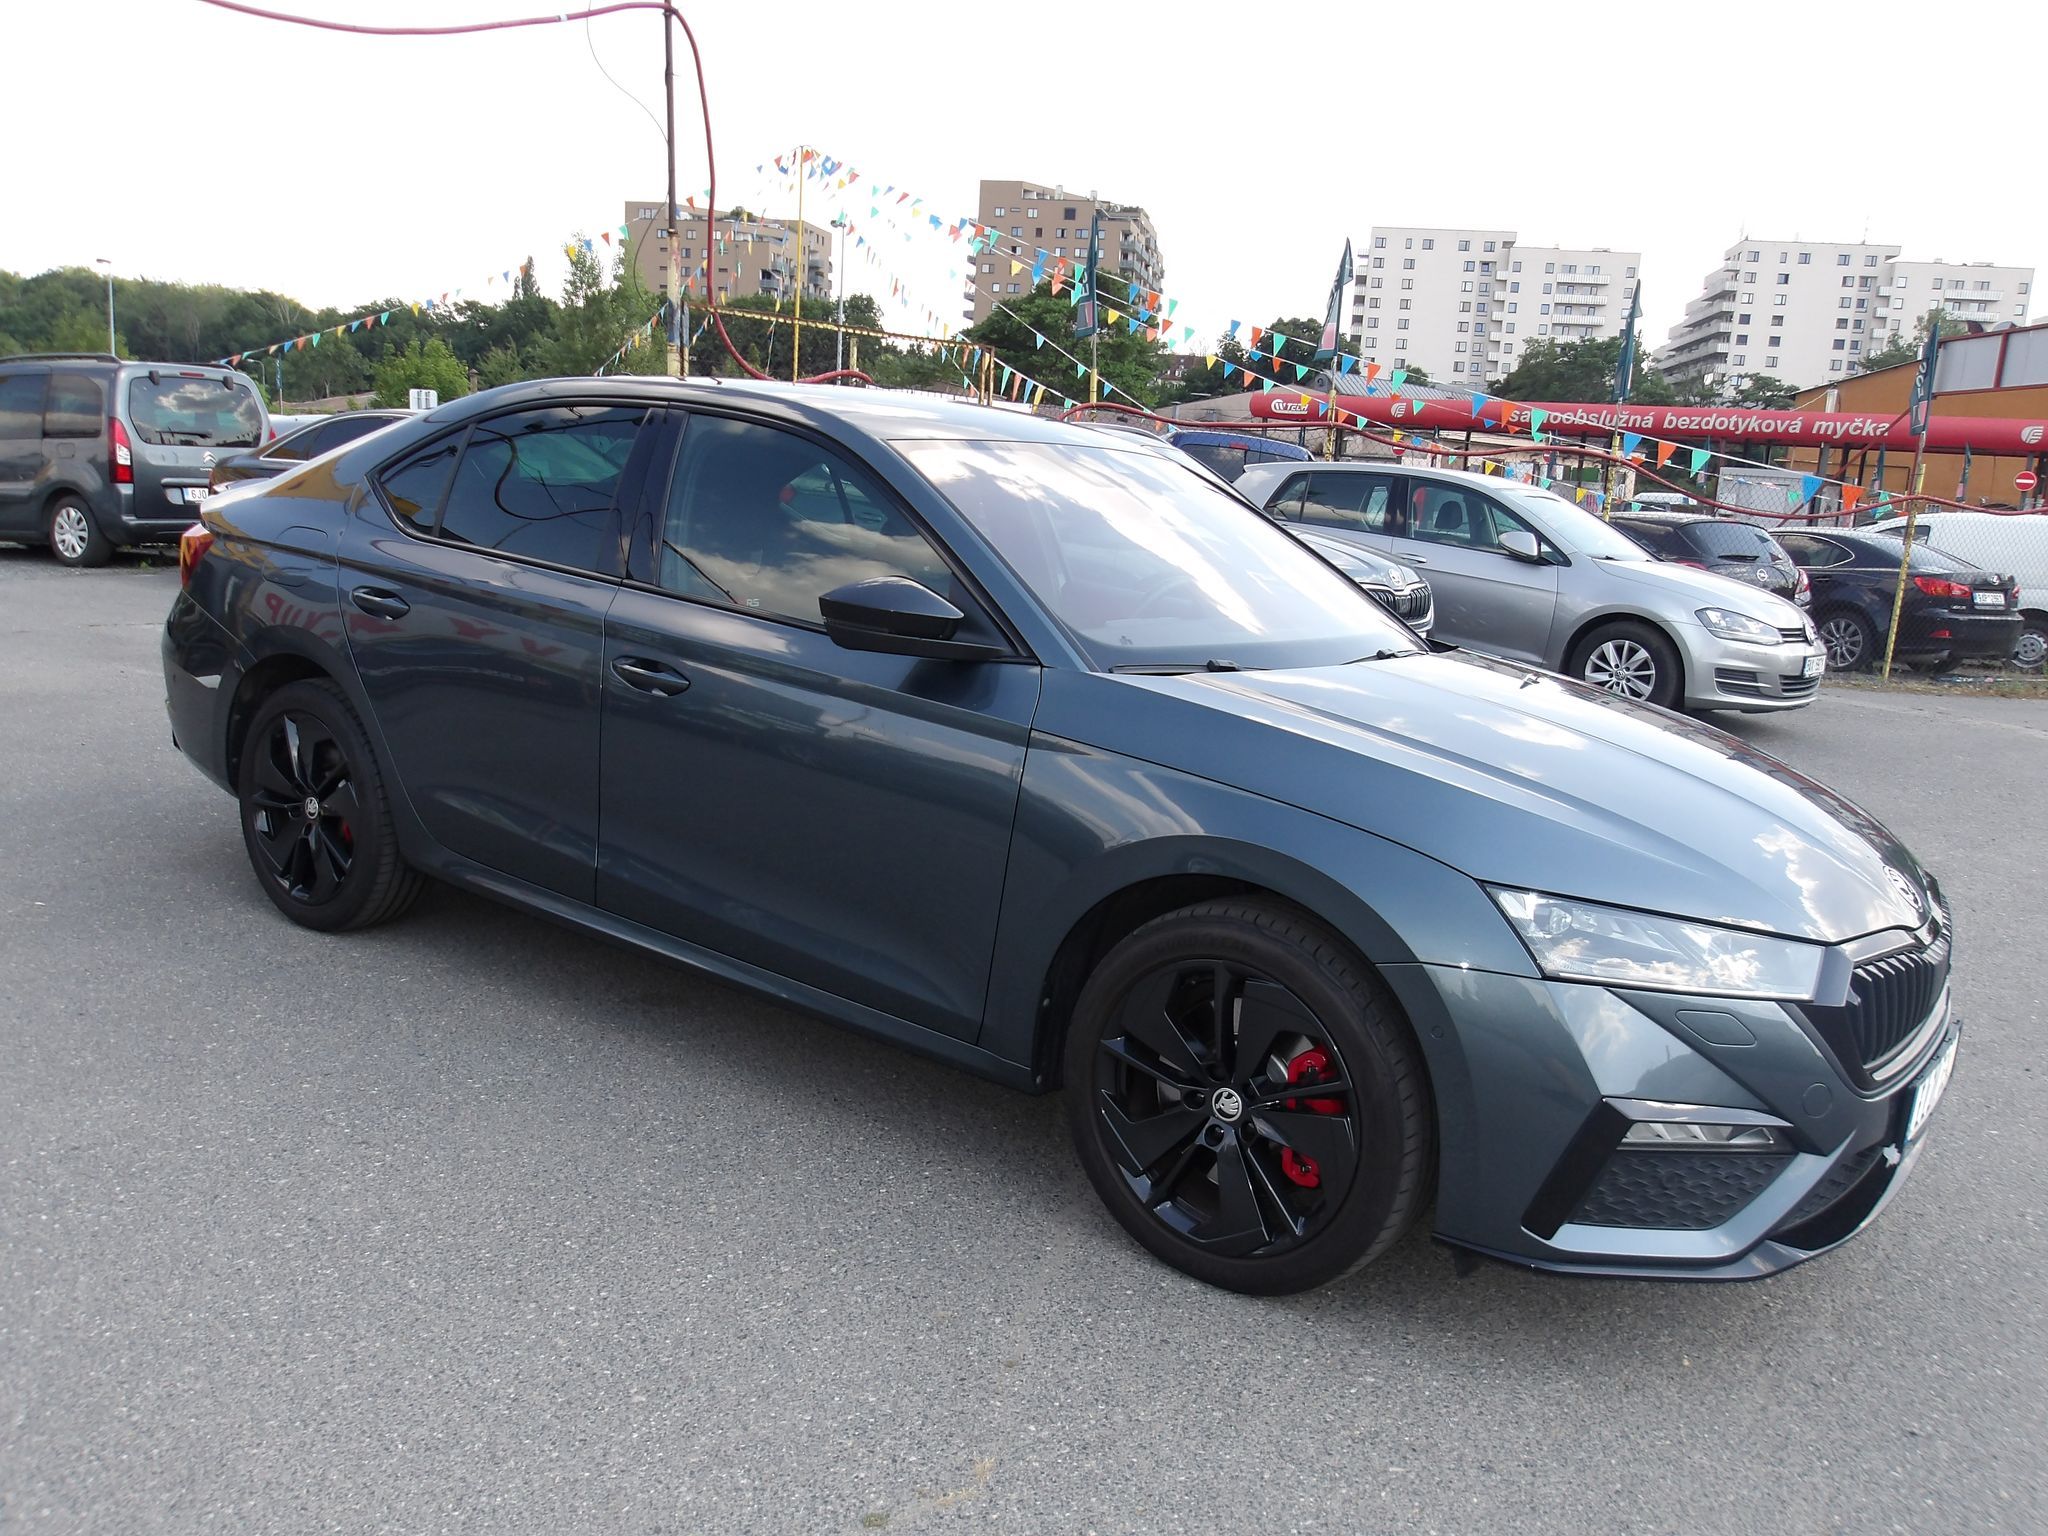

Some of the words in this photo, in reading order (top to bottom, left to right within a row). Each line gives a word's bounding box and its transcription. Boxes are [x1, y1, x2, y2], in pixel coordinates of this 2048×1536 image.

[1509, 408, 1655, 429] saoobslužná
[1663, 412, 1804, 435] bezdotyková
[1812, 418, 1890, 439] myčka
